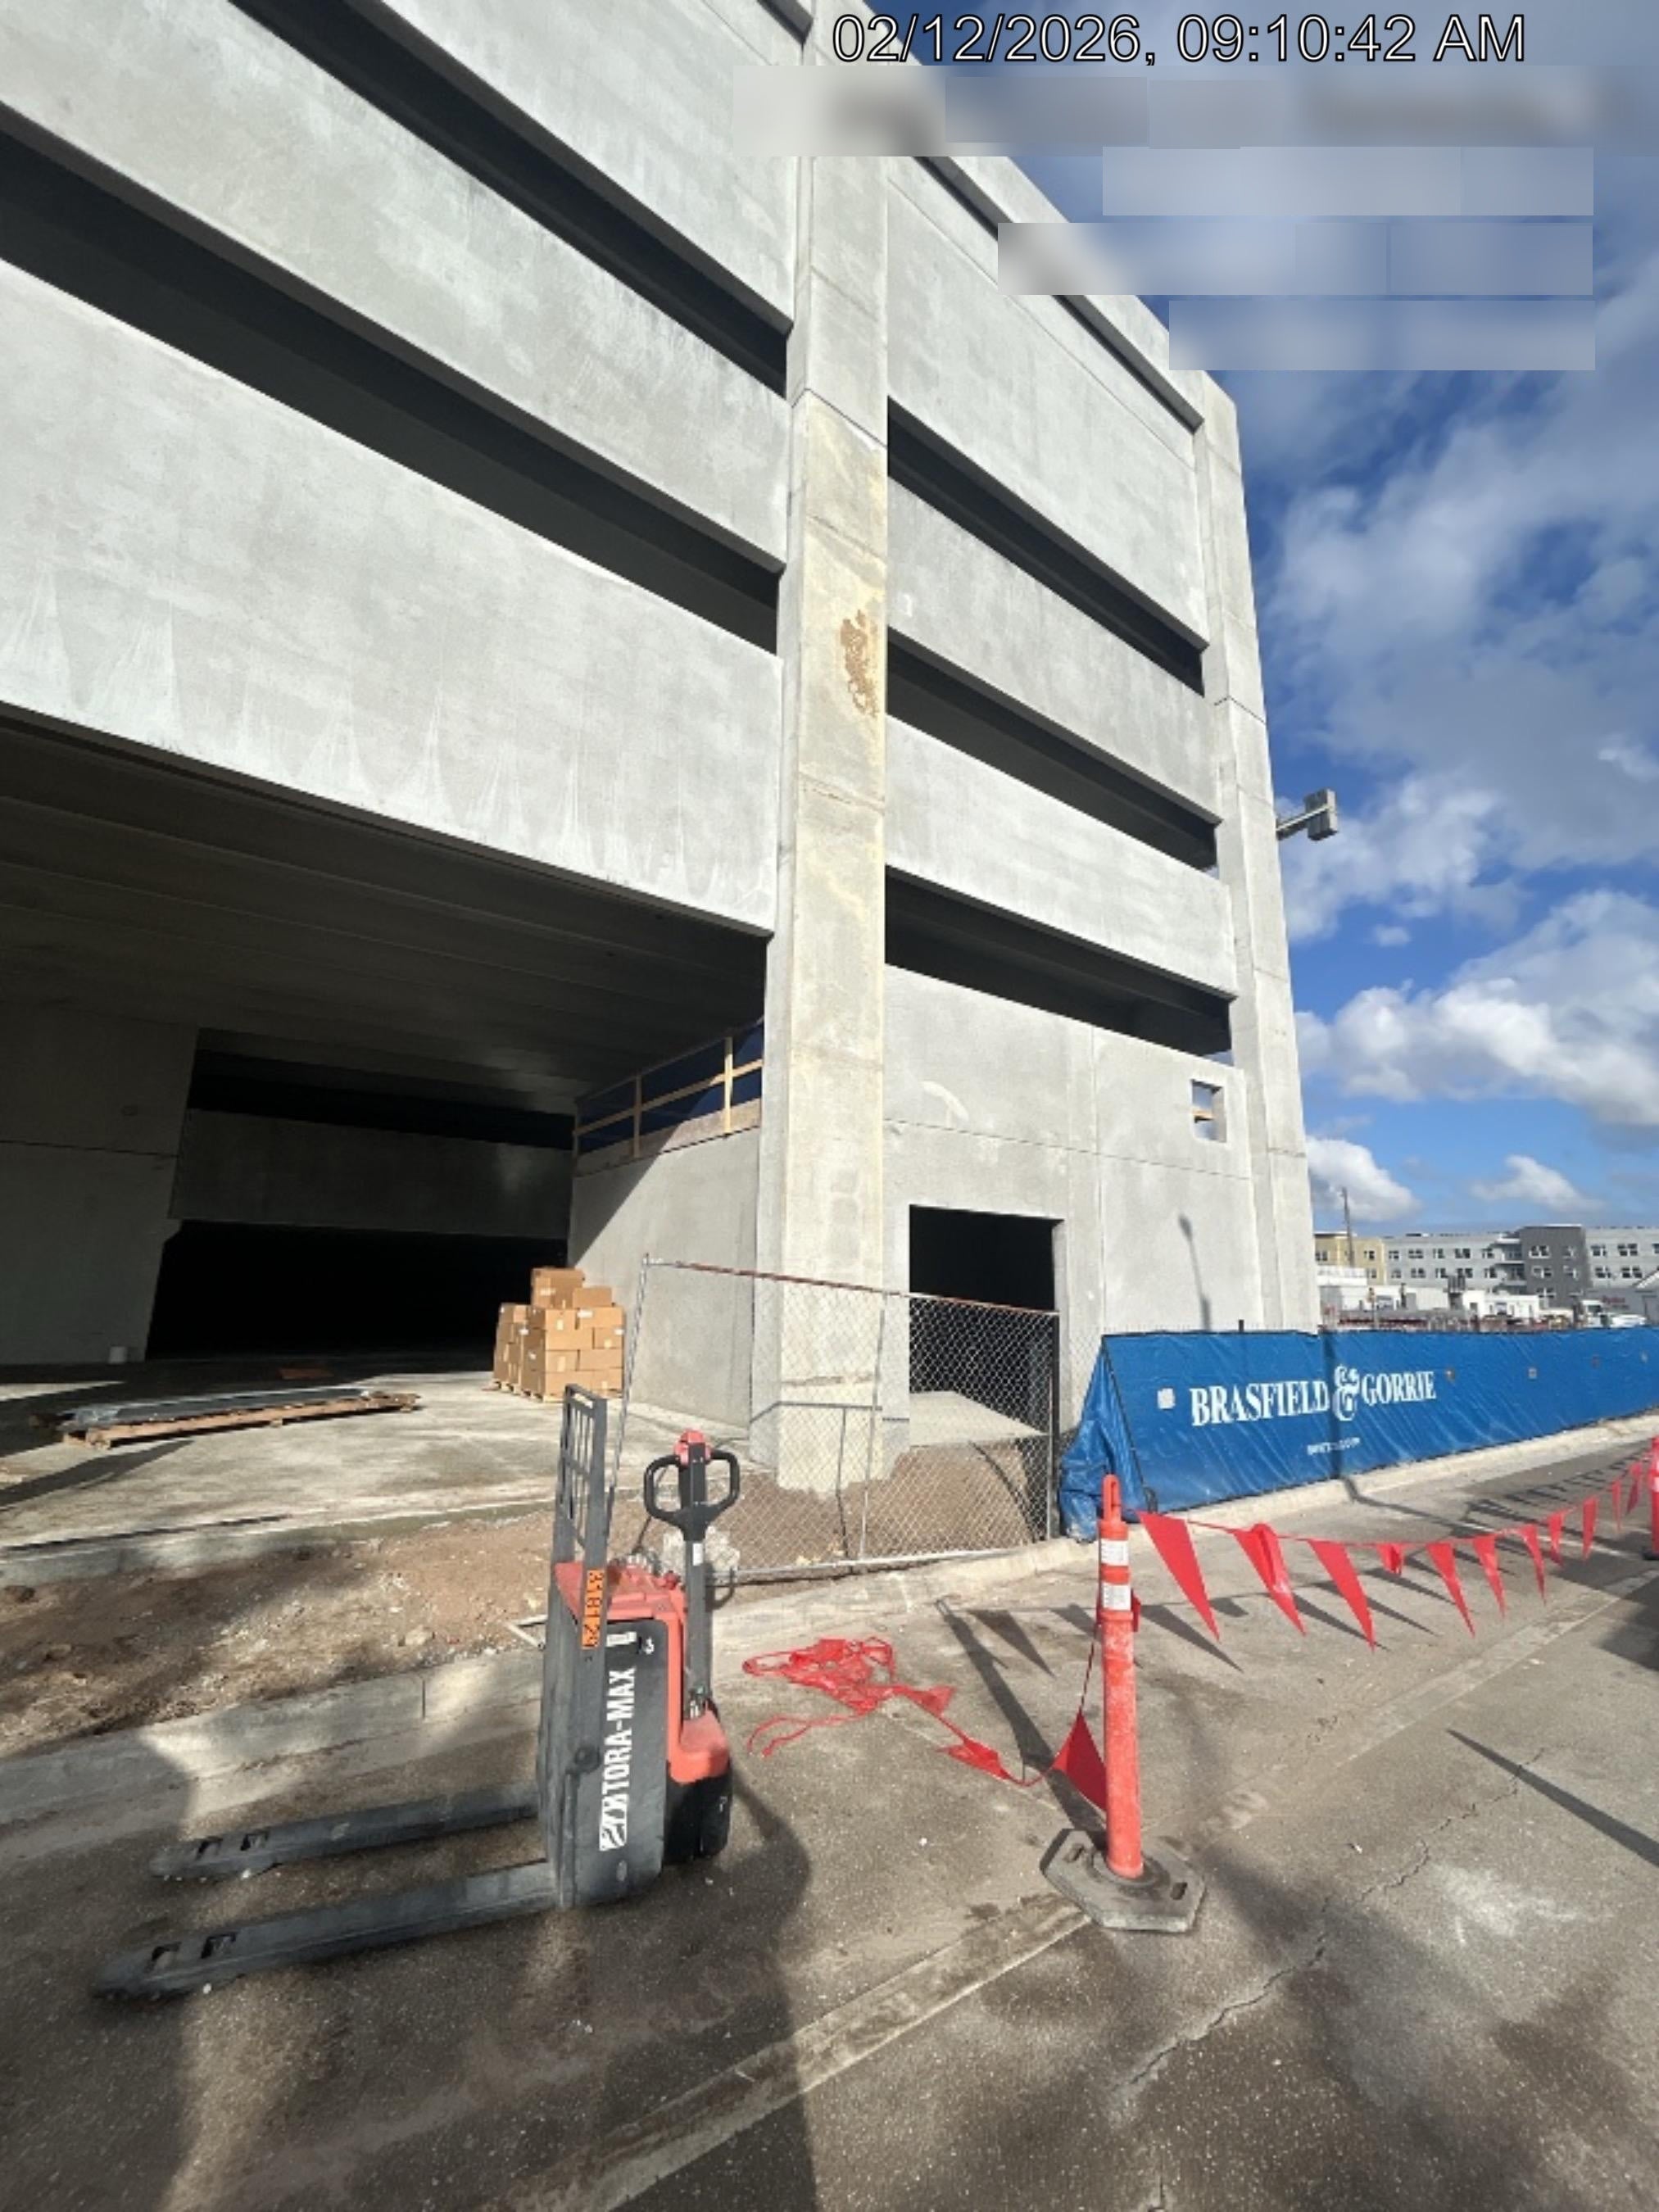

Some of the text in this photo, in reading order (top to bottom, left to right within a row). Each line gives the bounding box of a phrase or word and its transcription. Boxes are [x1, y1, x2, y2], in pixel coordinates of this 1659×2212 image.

[1190, 1364, 1436, 1426] BRASFIELD & GORRIE
[601, 1666, 637, 1795] TORA-MAX
